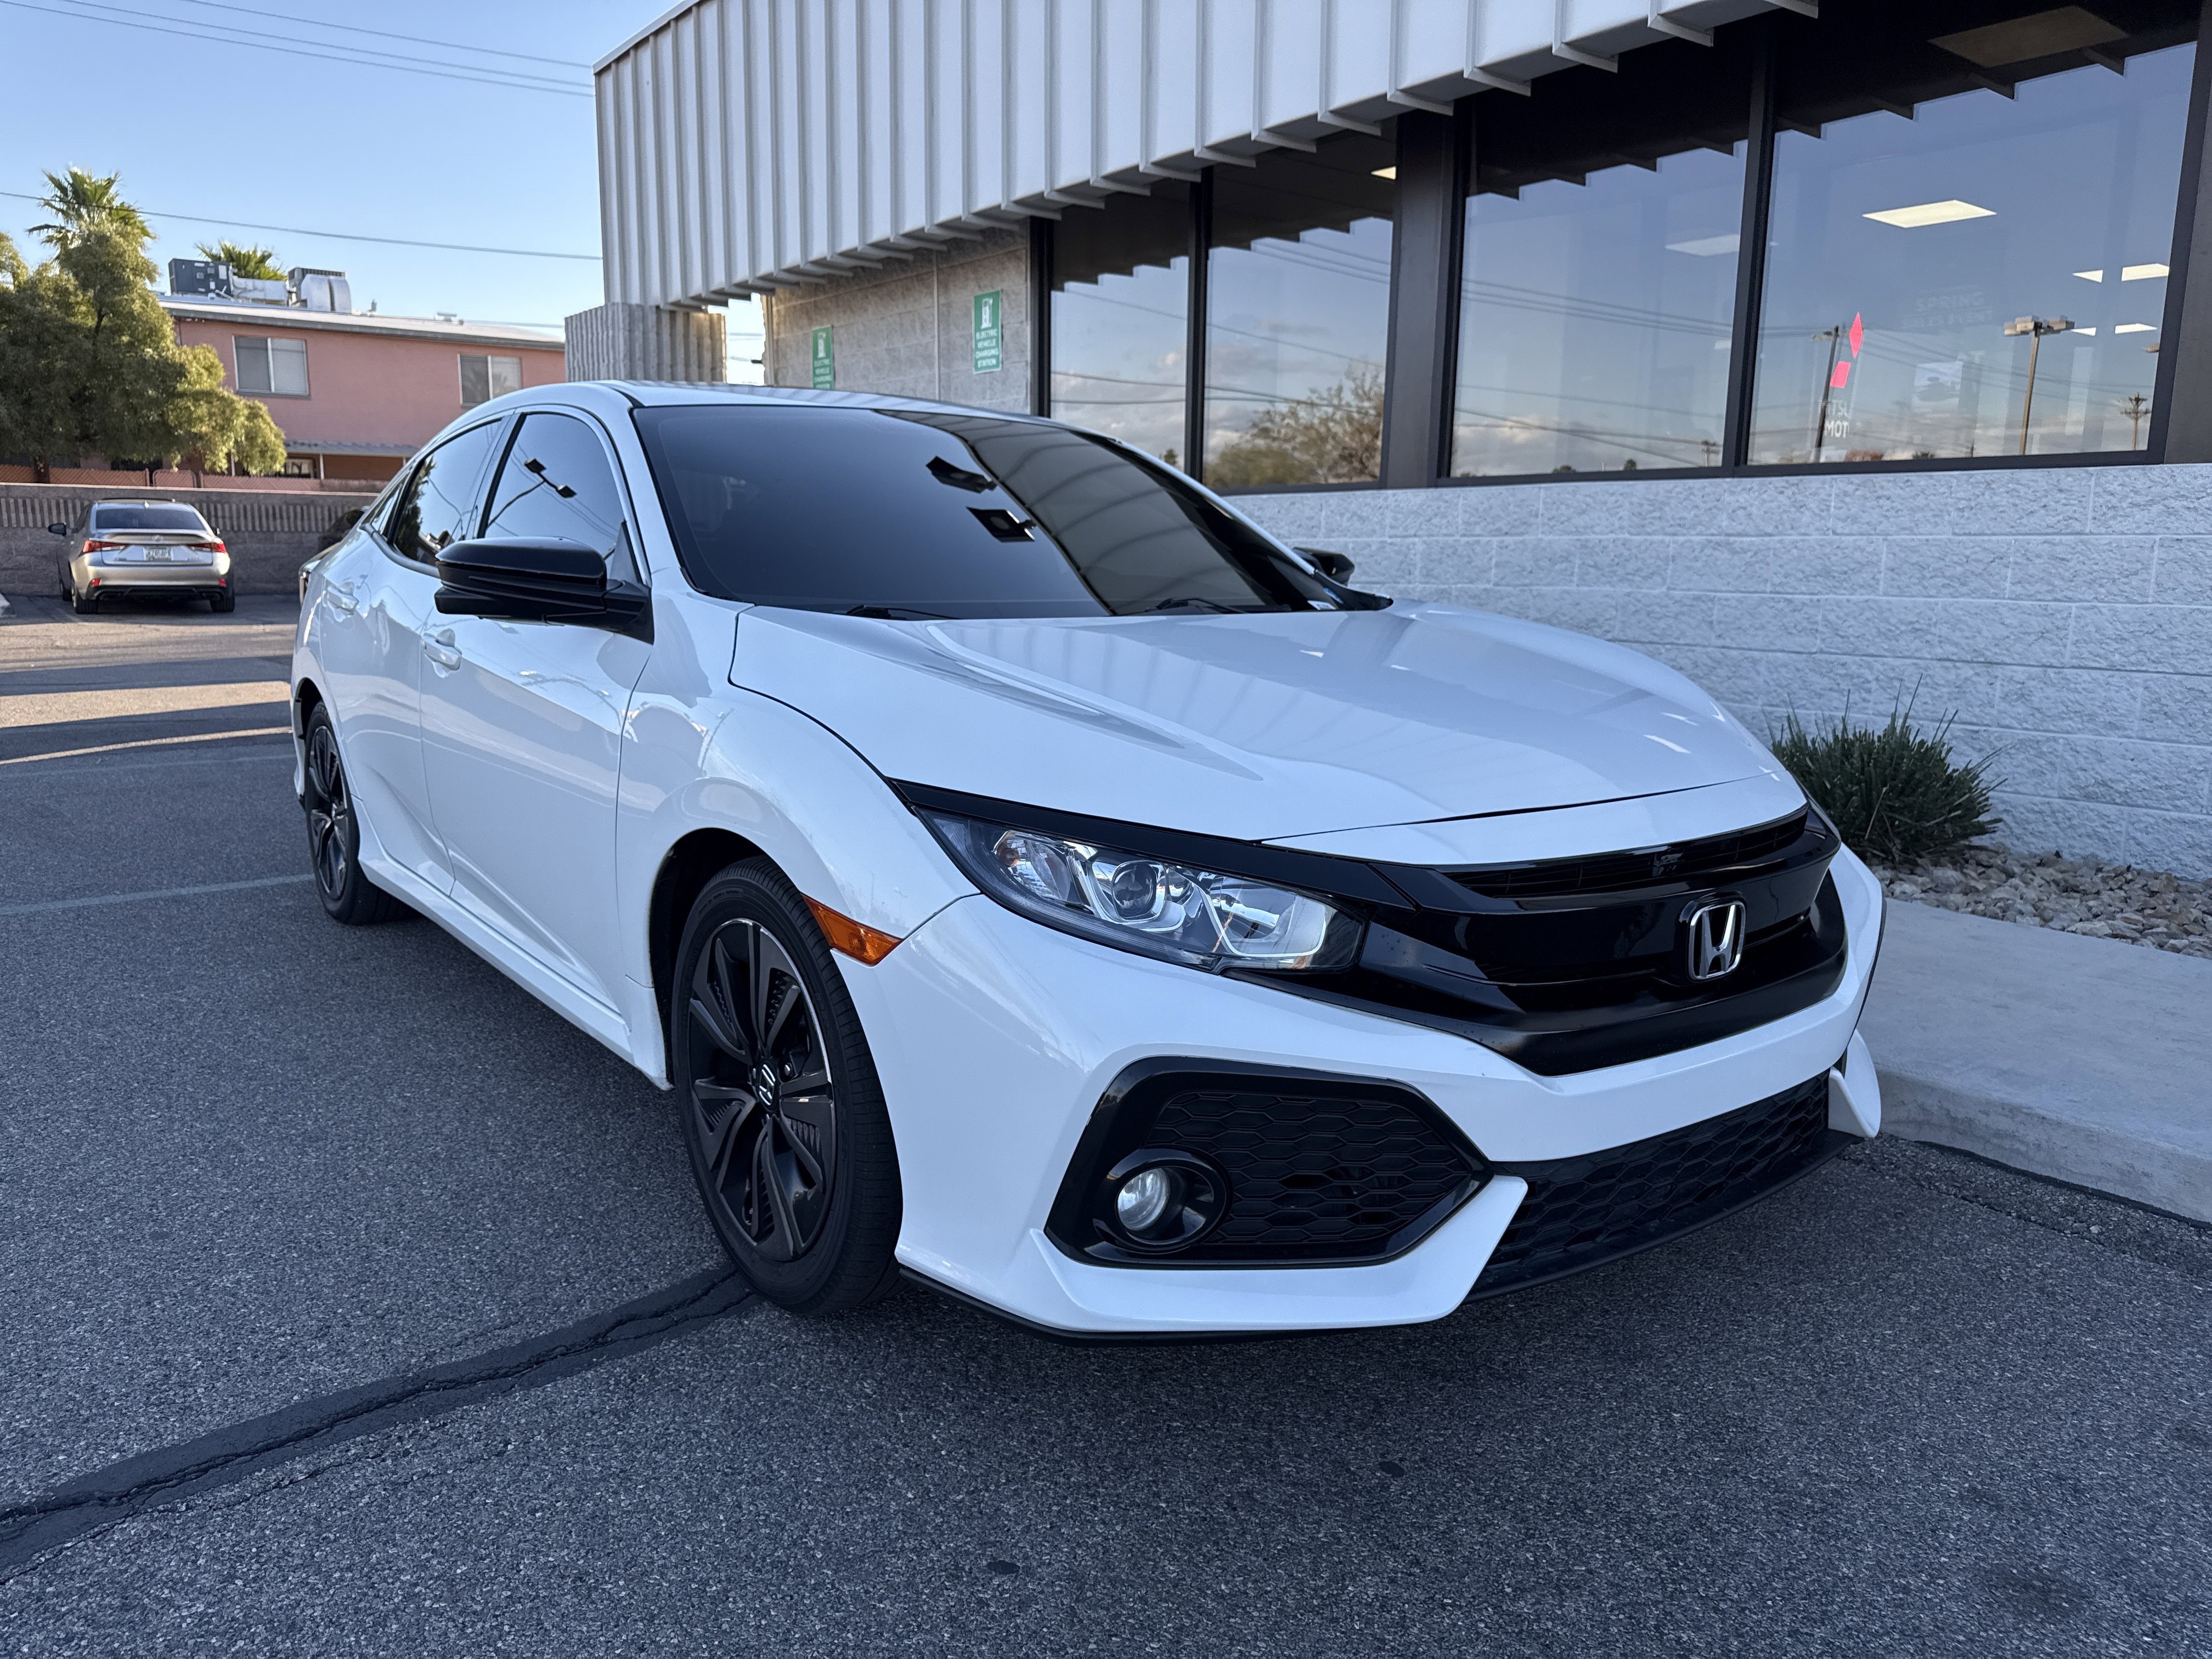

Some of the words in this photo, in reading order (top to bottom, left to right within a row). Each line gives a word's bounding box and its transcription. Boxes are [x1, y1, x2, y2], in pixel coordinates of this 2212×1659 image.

[975, 329, 997, 340] ELECTRIC
[977, 358, 997, 368] STATION
[1824, 420, 1849, 438] MOT
